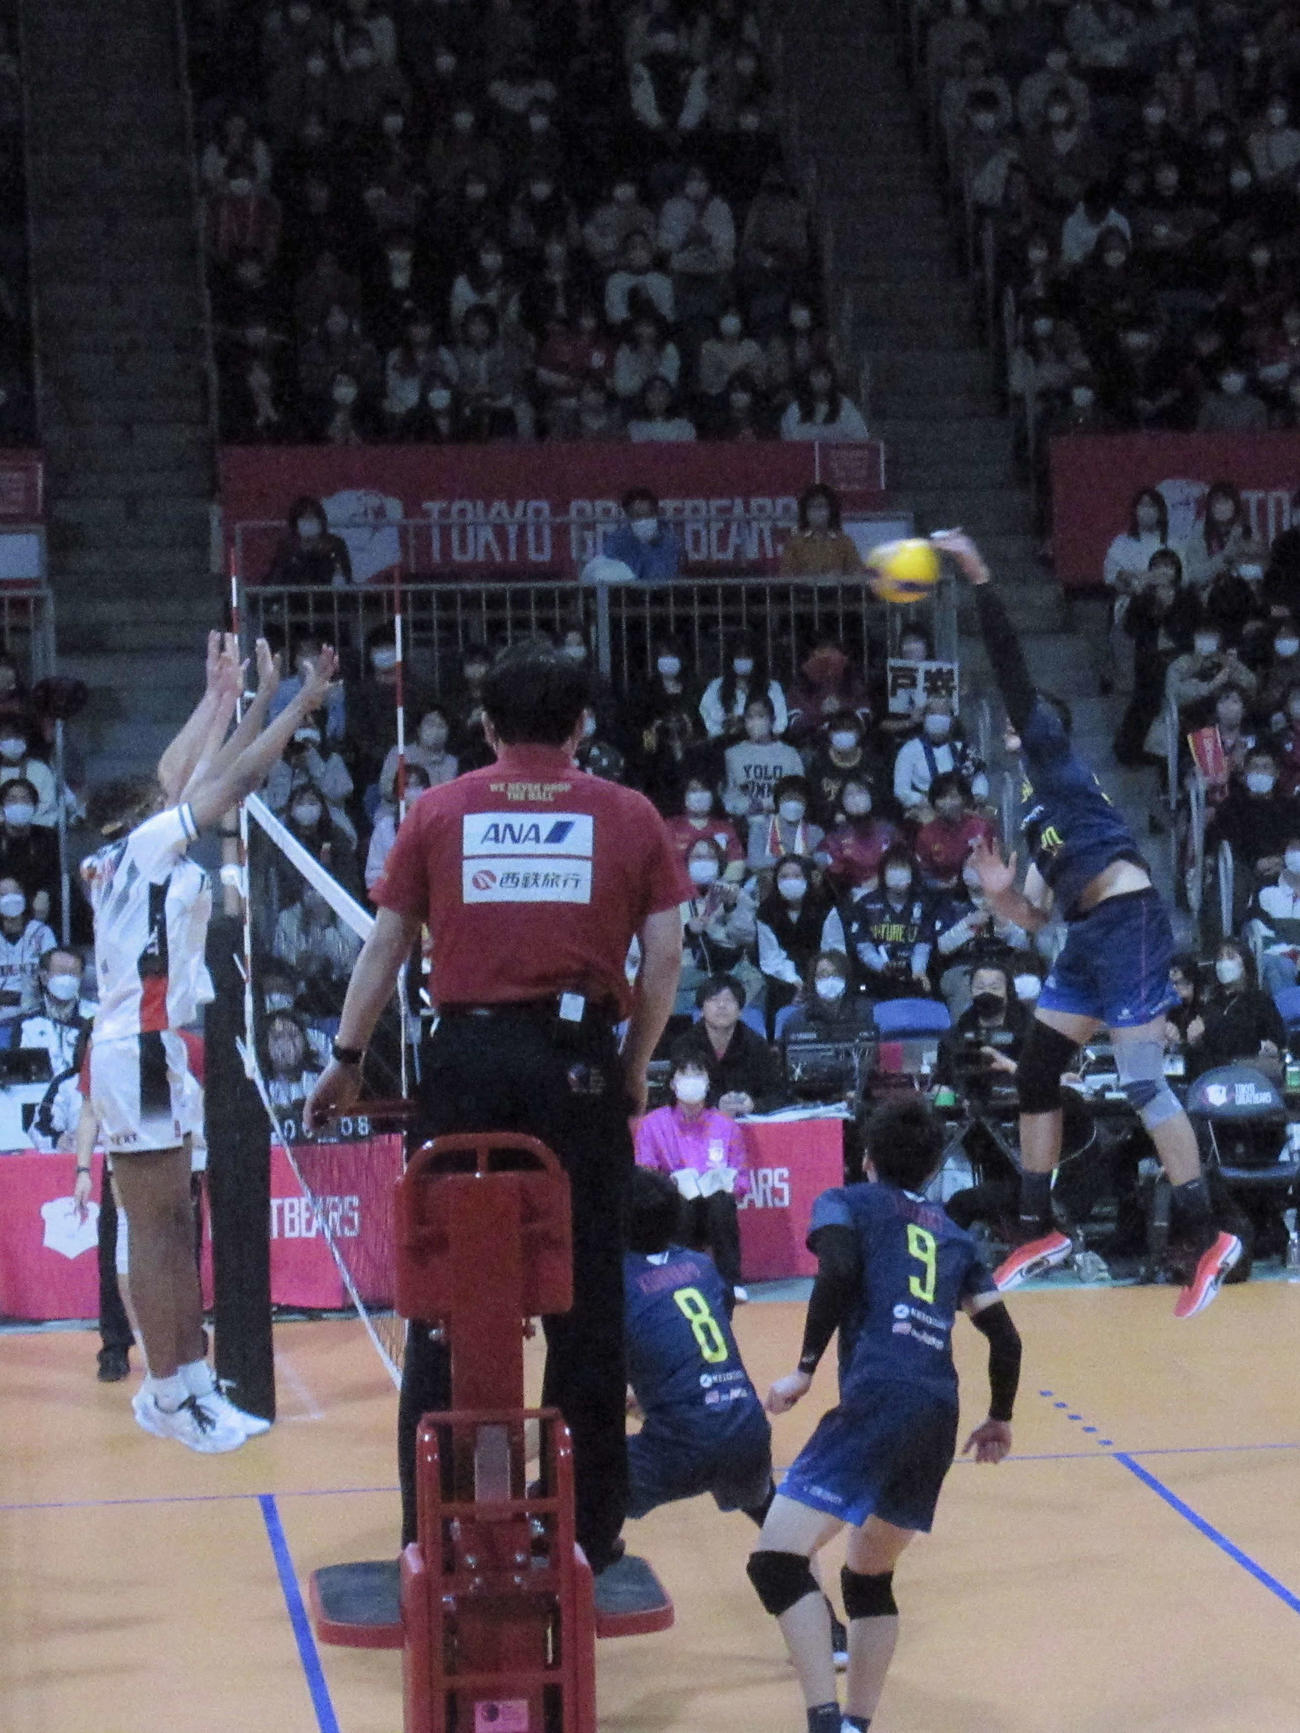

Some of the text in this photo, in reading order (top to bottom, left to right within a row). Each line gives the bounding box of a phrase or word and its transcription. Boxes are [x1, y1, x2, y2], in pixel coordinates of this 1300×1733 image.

[421, 500, 552, 562] TOKYO
[481, 823, 541, 844] ANA
[499, 872, 581, 890] 西鉄旅行
[737, 1167, 789, 1208] ARS
[907, 1224, 937, 1303] 9
[674, 1287, 728, 1363] 8
